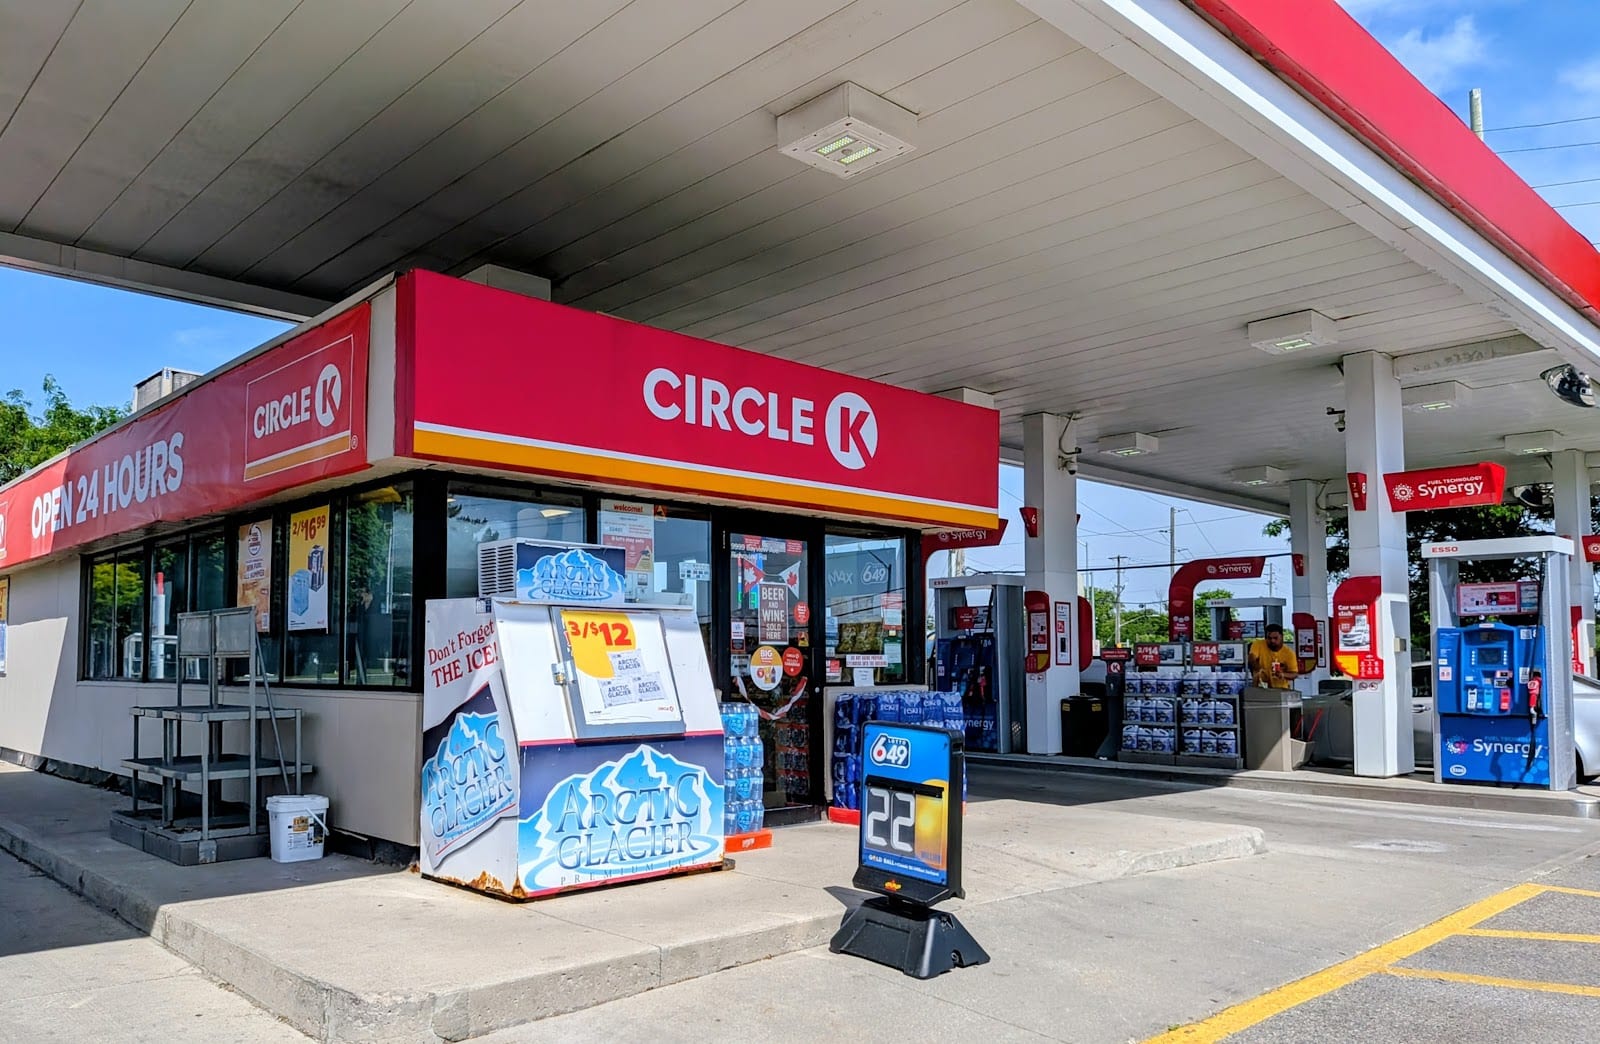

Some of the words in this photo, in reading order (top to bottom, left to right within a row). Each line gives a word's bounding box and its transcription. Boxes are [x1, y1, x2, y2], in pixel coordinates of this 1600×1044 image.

[254, 386, 311, 438] CIRCLE
[315, 364, 342, 427] K
[643, 368, 814, 445] CIRCLE
[825, 392, 878, 470] K
[31, 481, 73, 539] OPEN
[76, 470, 99, 524] 24
[103, 432, 184, 515] HOURS
[1443, 475, 1483, 484] TECHNOLOGY
[1418, 482, 1484, 498] Synergy
[614, 503, 643, 513] welcome!
[1031, 515, 1036, 524] 6
[951, 529, 987, 541] Synergy
[541, 560, 604, 582] ARCTIC
[1218, 565, 1252, 574] Synergy
[542, 580, 602, 596] GLACIER
[762, 587, 785, 601] BEER
[768, 601, 779, 609] AND
[762, 609, 785, 623] WINE
[568, 621, 632, 646] 3/$12
[766, 624, 781, 632] SOLD
[428, 640, 456, 665] Don't
[457, 619, 494, 650] Forget
[766, 632, 781, 640] HERE
[760, 649, 773, 658] BIG
[431, 659, 463, 688] THE
[465, 642, 499, 673] ICE!
[1110, 662, 1120, 673] K
[607, 690, 631, 698] GLACIER
[638, 686, 660, 694] GLACIER
[963, 719, 994, 730] ynergy
[1473, 739, 1543, 758] Synergy
[427, 720, 506, 806] ARCTIC
[431, 766, 512, 838] GLACIER
[555, 773, 699, 833] ARCTIC
[558, 820, 699, 869] GLACIER
[868, 854, 882, 863] GOLD
[883, 857, 895, 866] BALL
[561, 864, 653, 885] PREMIUM
